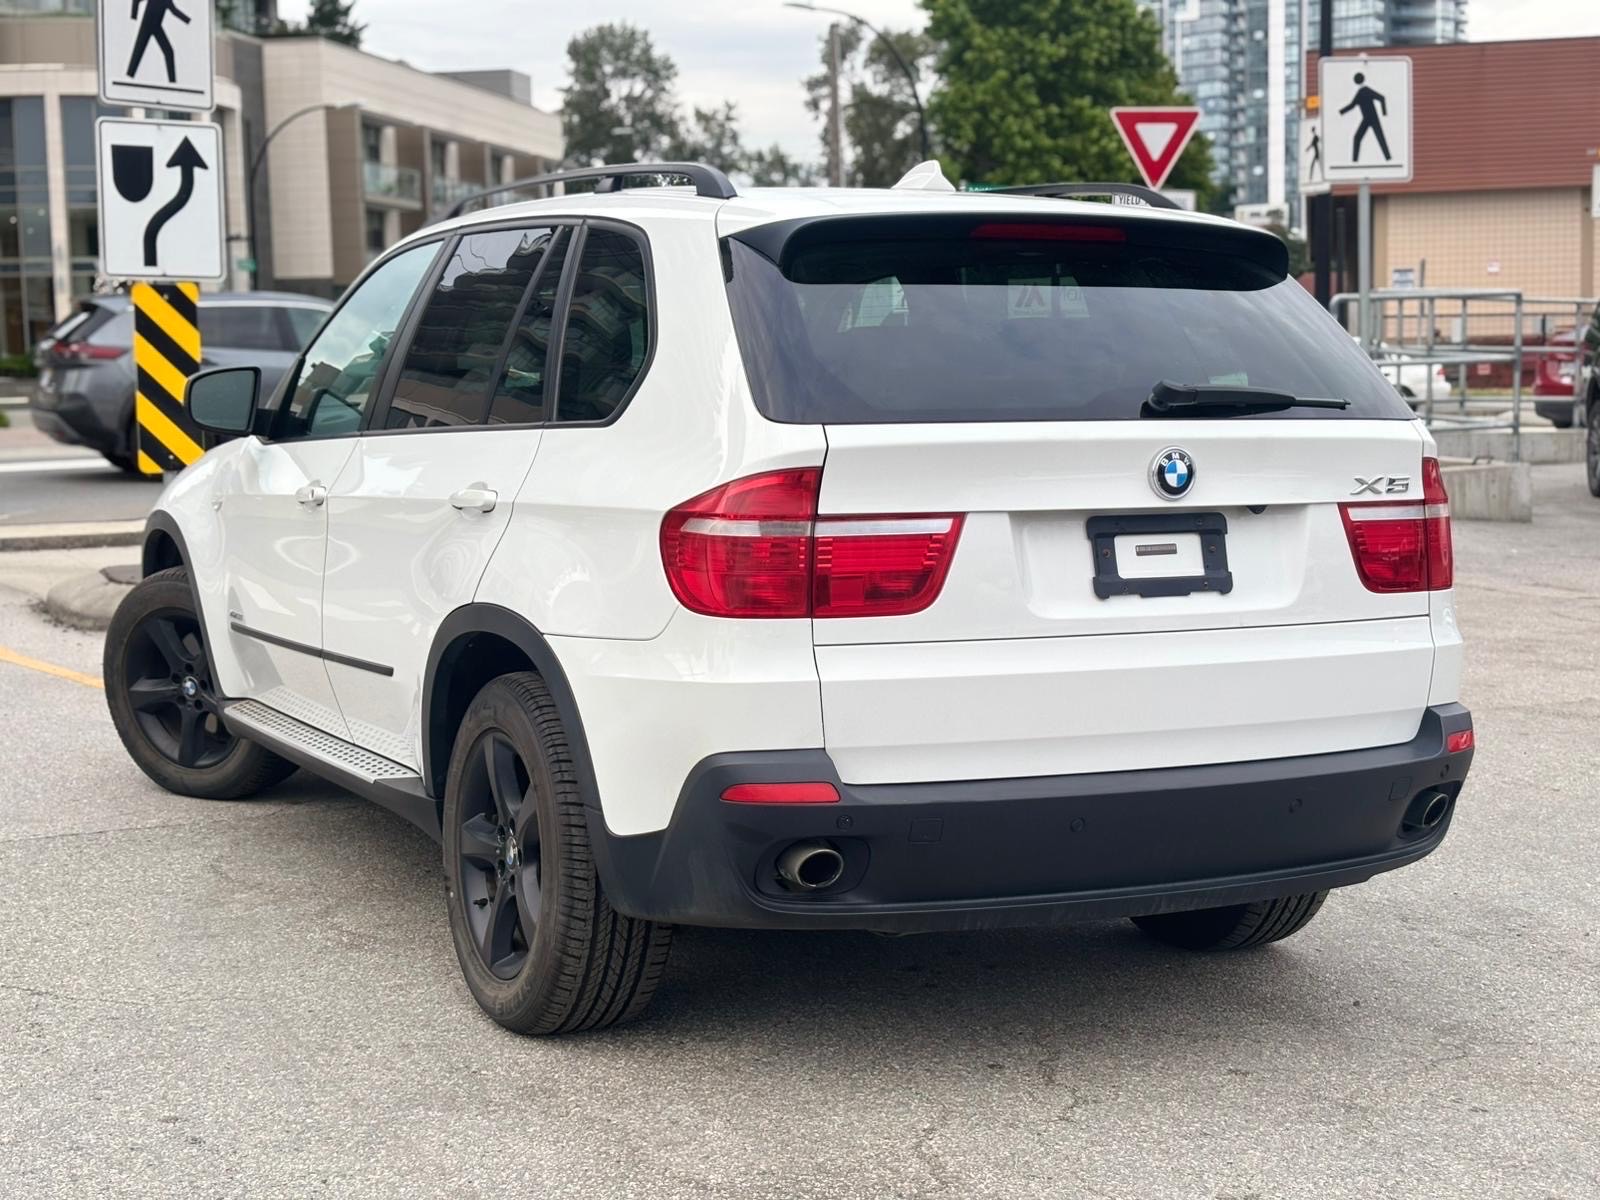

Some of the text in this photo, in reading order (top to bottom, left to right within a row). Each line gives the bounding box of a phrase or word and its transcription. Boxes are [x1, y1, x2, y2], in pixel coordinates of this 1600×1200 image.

[1118, 194, 1141, 205] YIELD
[1160, 452, 1191, 467] BMW
[1350, 475, 1411, 496] X5
